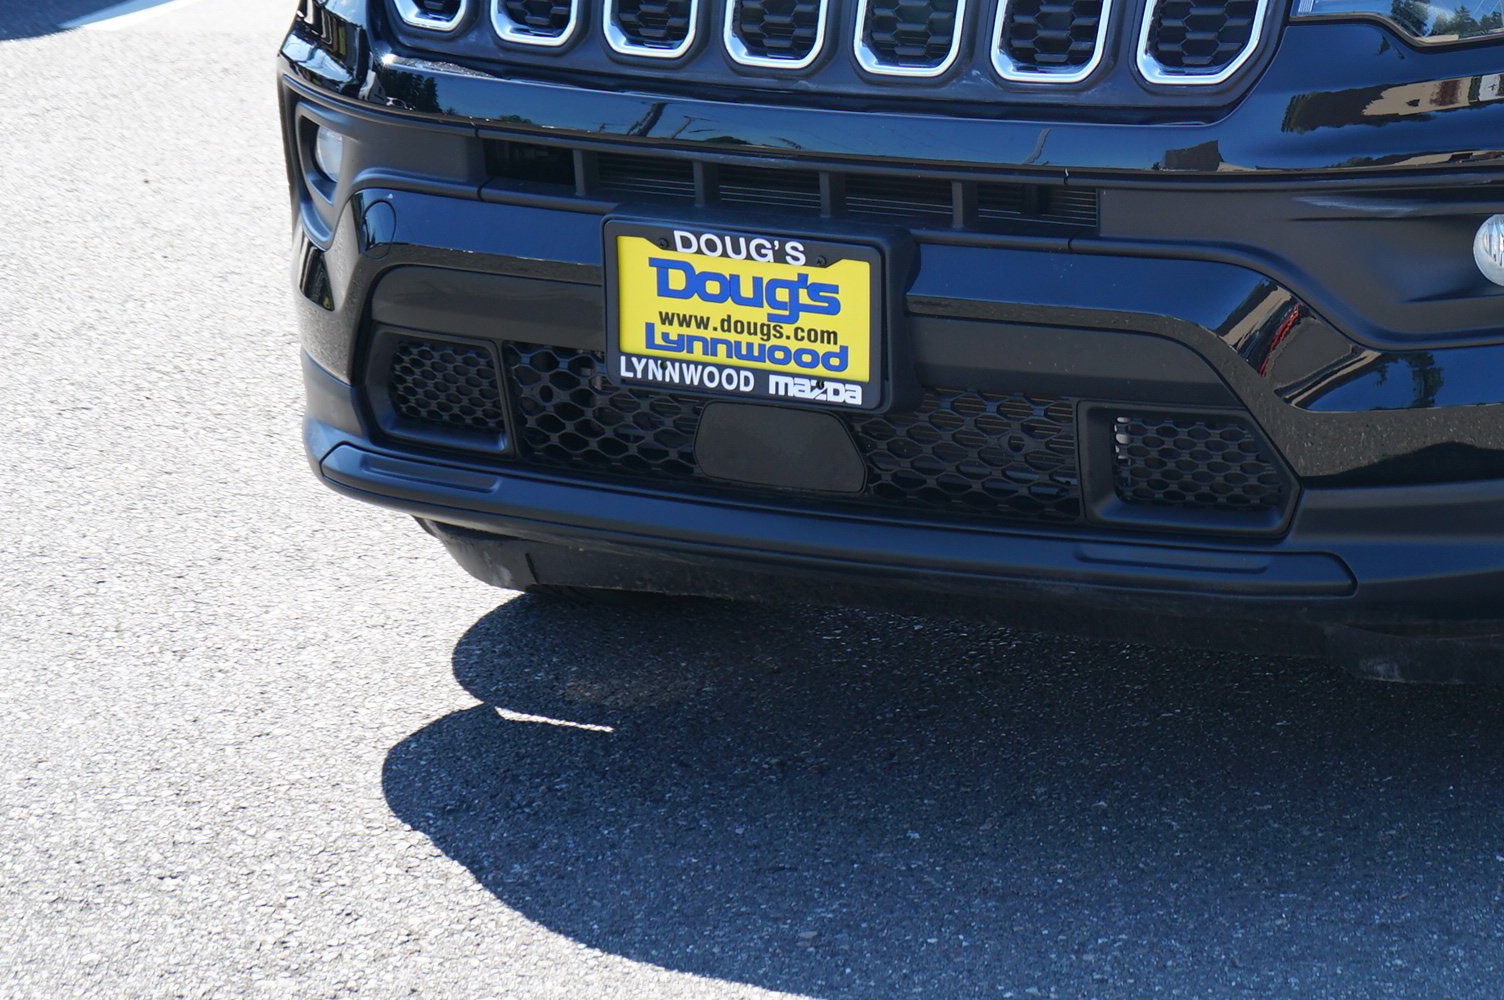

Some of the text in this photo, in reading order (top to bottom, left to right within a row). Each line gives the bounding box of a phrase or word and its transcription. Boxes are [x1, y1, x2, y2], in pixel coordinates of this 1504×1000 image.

[673, 230, 807, 266] DOUG'S
[648, 257, 842, 325] Doug's
[644, 322, 849, 372] Lynnwood
[658, 310, 839, 346] www.dougs.com
[619, 355, 756, 393] LYNNWOOD
